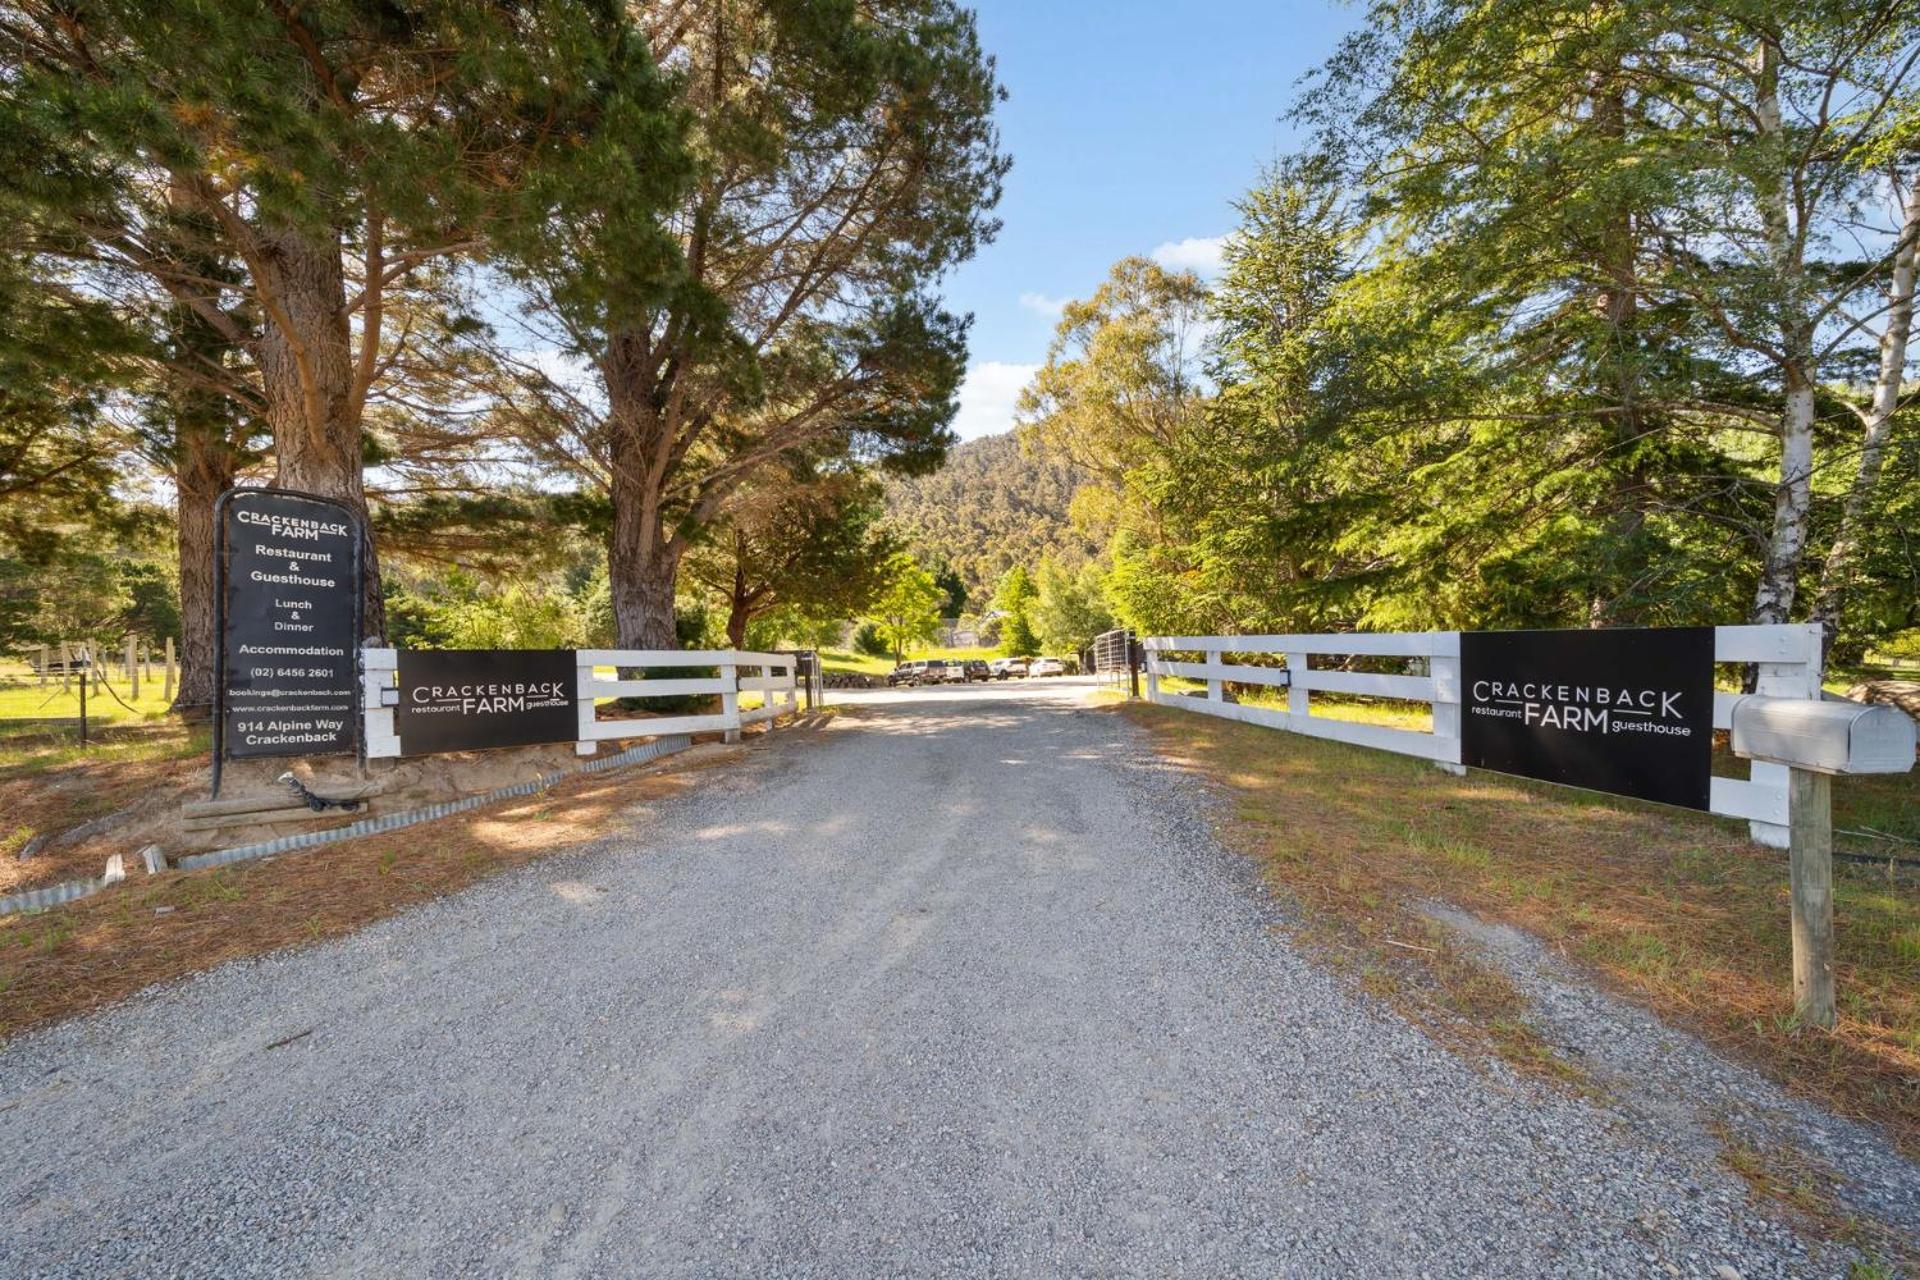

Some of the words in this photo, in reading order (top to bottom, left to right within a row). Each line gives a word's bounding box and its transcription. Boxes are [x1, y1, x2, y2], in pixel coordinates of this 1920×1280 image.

[237, 511, 348, 536] CRACKENBACK
[271, 524, 318, 540] FARM
[255, 544, 332, 562] Restaurant
[289, 562, 299, 571] &
[250, 571, 336, 587] Guesthouse
[275, 599, 312, 609] Lunch
[291, 611, 300, 620] &
[274, 622, 314, 632] Dinner
[239, 645, 344, 656] Accommodation
[250, 668, 274, 679] (02)
[277, 668, 305, 678] 6456
[308, 669, 334, 678] 2601
[412, 682, 565, 703] CRACKENBACK
[1473, 680, 1683, 719] CRACKENBACK
[411, 704, 461, 714] restaurant
[463, 696, 524, 715] FARM
[526, 700, 569, 710] guesthouse
[238, 721, 264, 732] 914
[267, 720, 312, 732] Alpine
[315, 719, 343, 731] Way
[1471, 705, 1522, 719] restaurant
[1524, 702, 1608, 734] FARM
[1612, 719, 1692, 737] guesthouse
[246, 731, 336, 745] Crackenback
